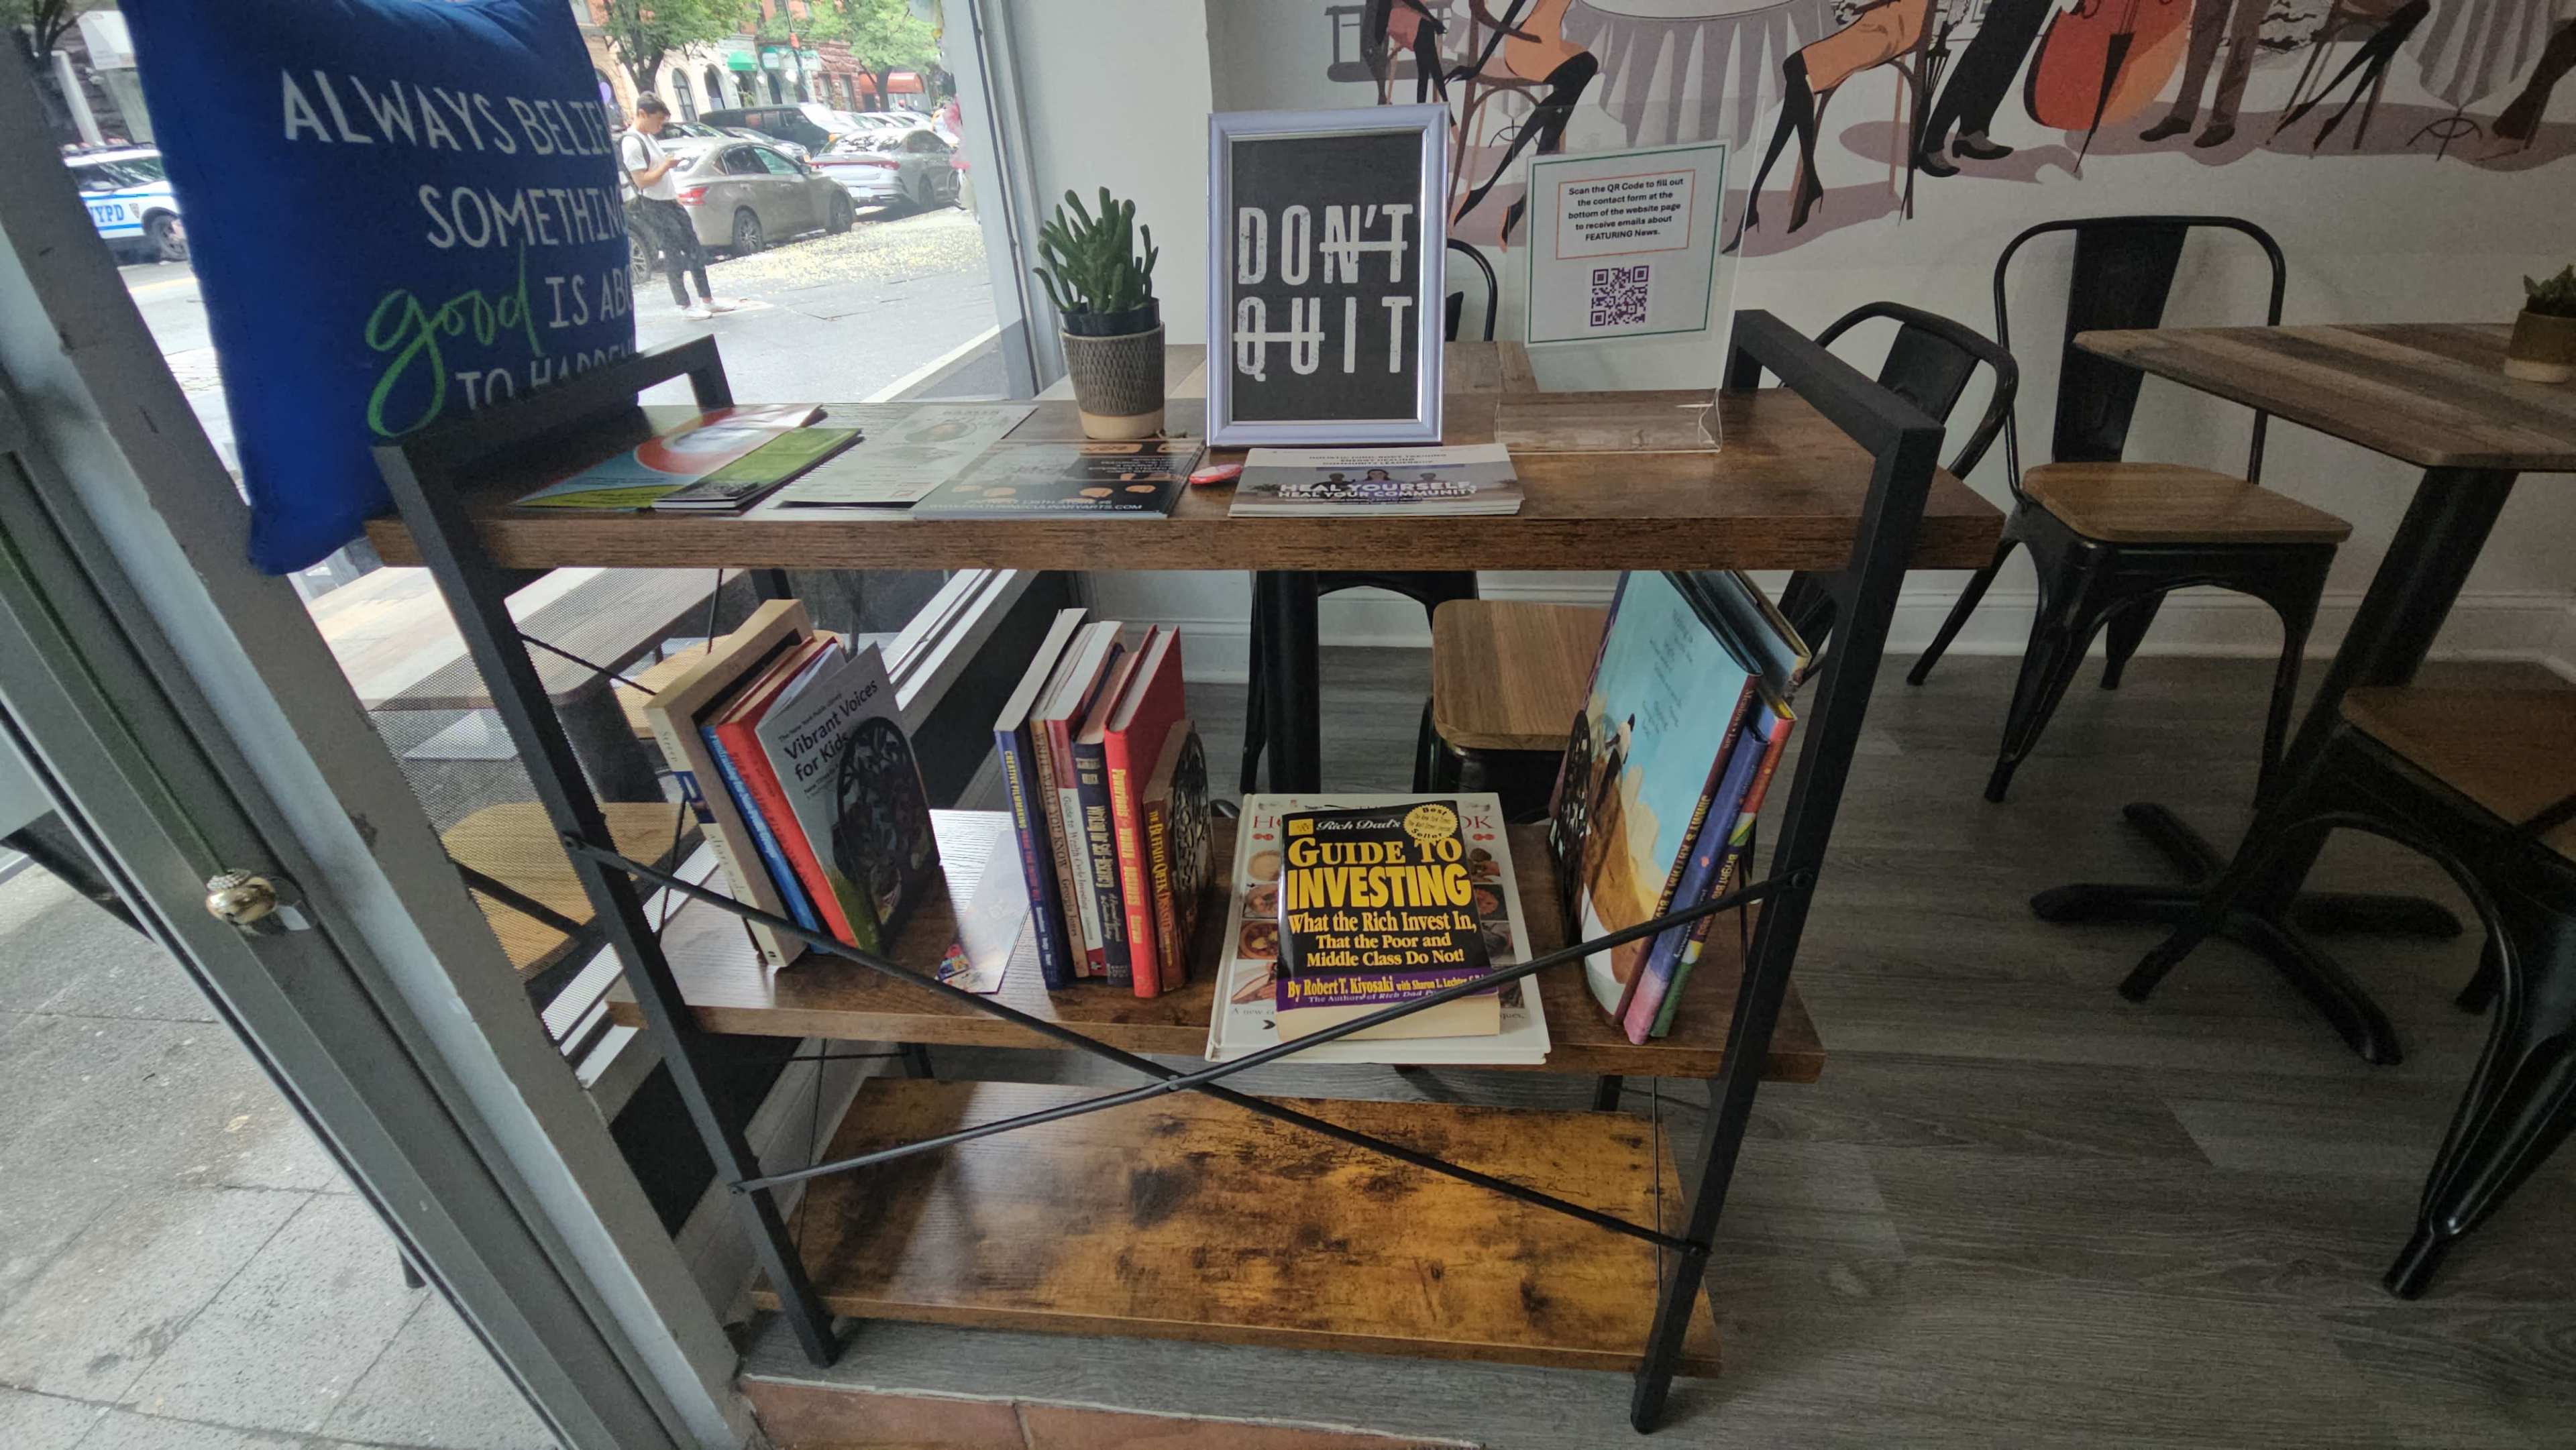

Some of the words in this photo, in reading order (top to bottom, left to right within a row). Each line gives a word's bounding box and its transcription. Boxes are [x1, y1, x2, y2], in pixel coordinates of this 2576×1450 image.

[282, 68, 517, 154] ALWAYS
[1568, 187, 1590, 196] Scan
[1607, 183, 1621, 193] QR
[1621, 182, 1644, 190] Code
[1593, 196, 1625, 206] contact
[1627, 194, 1647, 202] form
[89, 204, 125, 223] YPD
[1568, 211, 1599, 219] bottom
[1610, 208, 1624, 216] the
[1625, 205, 1659, 214] website
[1660, 203, 1681, 213] page
[1575, 223, 1584, 231] to
[1585, 221, 1615, 230] receive
[1617, 218, 1646, 227] emails
[1648, 215, 1672, 224] about
[1238, 203, 1413, 285] DON'T
[1585, 230, 1633, 241] FEATURING
[545, 274, 590, 328] IS
[365, 239, 548, 437] good
[1234, 296, 1413, 382] QUIT
[455, 368, 515, 410] TO
[1280, 484, 1342, 492] HEAL
[1374, 488, 1478, 497] COMMUNITY
[784, 712, 841, 760] Vibrant
[839, 679, 878, 717] Voices
[1034, 733, 1051, 769] WRITE
[794, 757, 819, 781] for
[1004, 750, 1020, 795] CREATIVE
[1013, 795, 1027, 829] FILMMAKING
[1042, 773, 1056, 805] WHAT
[1049, 809, 1061, 833] YOU
[1421, 807, 1448, 816] Best
[1316, 820, 1354, 831] Rich
[1355, 818, 1401, 830] Dad's
[1411, 828, 1443, 839] Seller
[1054, 838, 1067, 867] KNOW
[1063, 796, 1074, 820] Guide
[1069, 832, 1081, 859] Wealth
[1077, 879, 1091, 910] Investing
[1148, 823, 1165, 865] BUFFALO
[1288, 837, 1406, 867] GUIDE
[1414, 837, 1462, 863] TO
[1061, 878, 1075, 915] Georgia
[1287, 863, 1472, 910] INVESTING
[1067, 915, 1077, 937] Jones
[1288, 911, 1329, 934] What
[1332, 910, 1358, 932] the
[1362, 910, 1400, 932] Rich
[1402, 911, 1451, 932] Invest
[1452, 910, 1477, 933] In,
[1316, 933, 1351, 950] That
[1354, 933, 1379, 948] the
[1381, 935, 1419, 948] Poor
[1422, 932, 1452, 947] and
[1307, 950, 1360, 967] Middle
[1362, 950, 1402, 966] Class
[1405, 950, 1430, 964] Do
[1432, 948, 1465, 963] Not!
[1287, 981, 1301, 1003] By
[1303, 978, 1338, 996] Robert
[1338, 977, 1349, 995] T.
[1350, 974, 1394, 998] Kiyosaki
[1396, 980, 1411, 992] with
[1435, 978, 1443, 989] L.
[1379, 992, 1400, 1000] Rich
[1232, 1007, 1240, 1015] A
